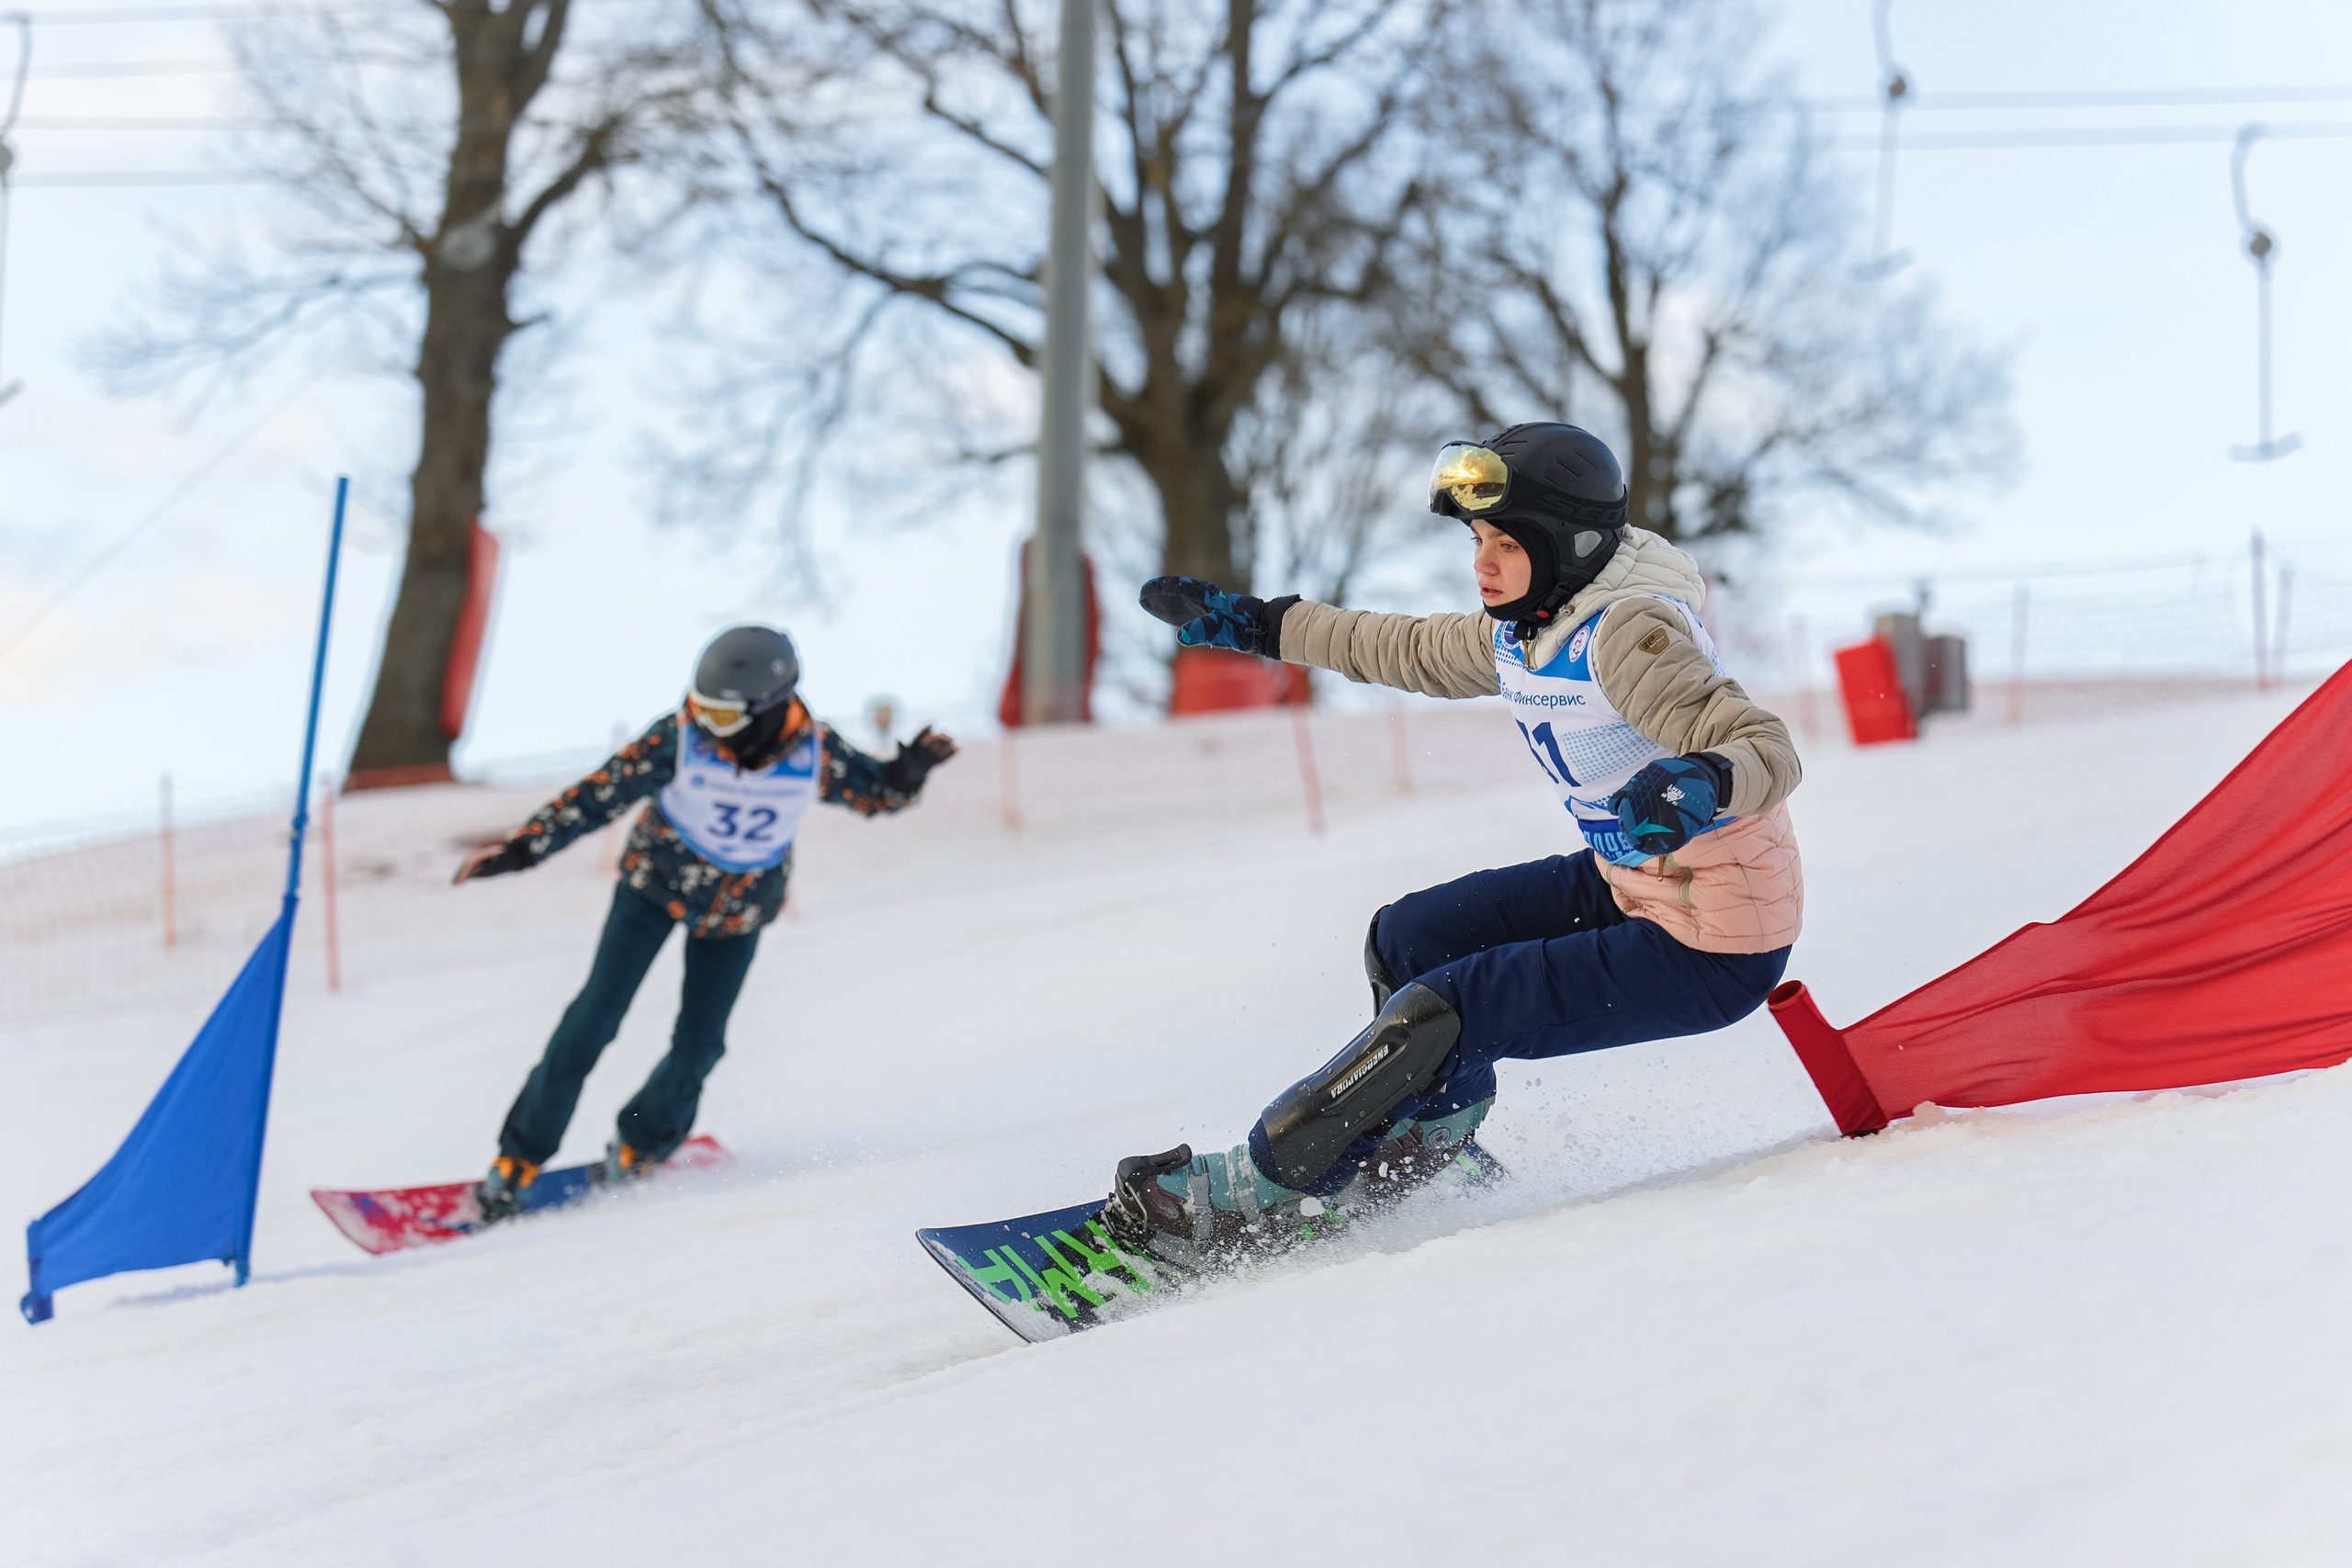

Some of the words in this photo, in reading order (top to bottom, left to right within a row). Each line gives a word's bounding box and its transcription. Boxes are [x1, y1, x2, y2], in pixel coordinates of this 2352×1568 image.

[1513, 690, 1587, 710] Финсервис
[707, 801, 778, 841] 32
[1330, 1043, 1389, 1099] ENERGIAPURA
